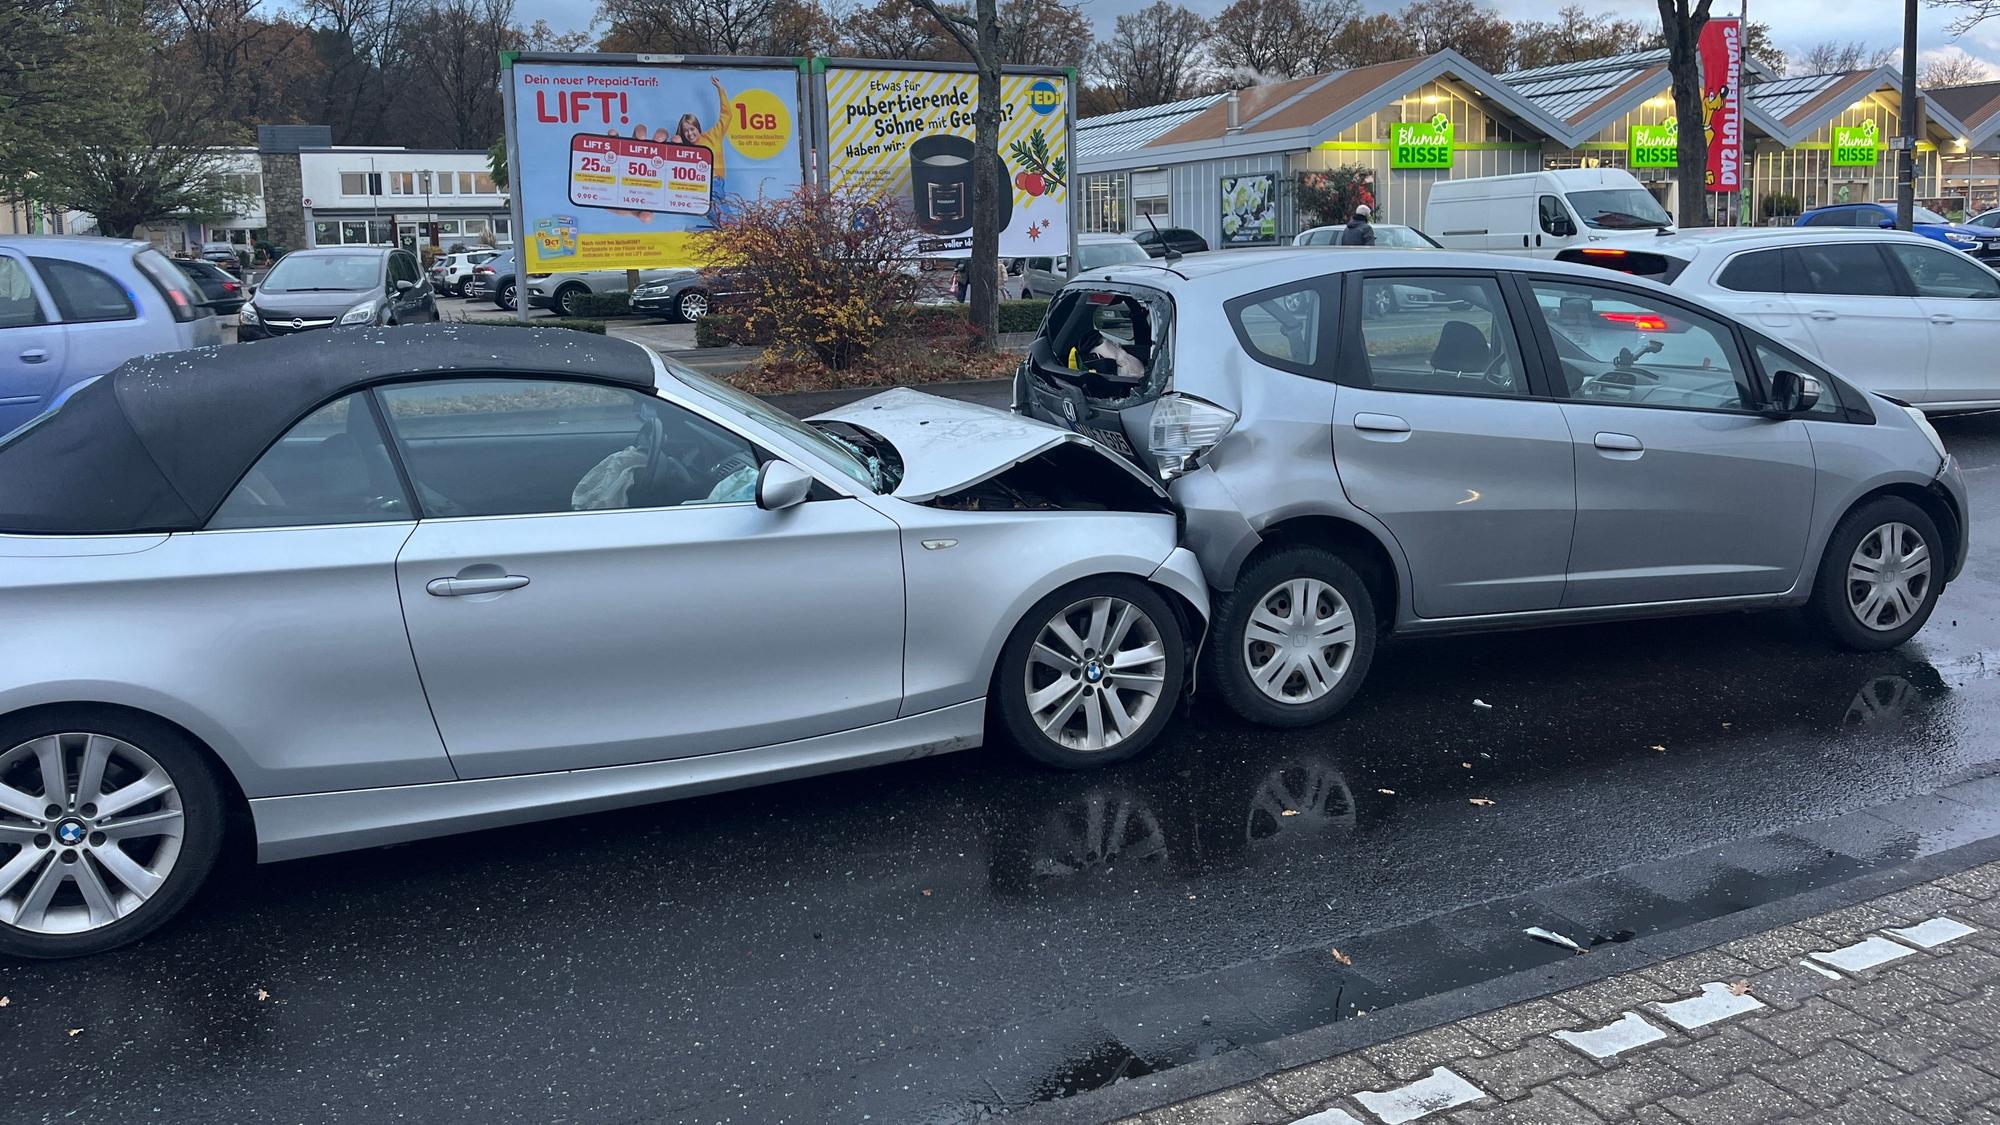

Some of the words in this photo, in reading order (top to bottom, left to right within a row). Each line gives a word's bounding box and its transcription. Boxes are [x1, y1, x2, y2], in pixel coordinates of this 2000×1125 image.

[525, 75, 549, 84] Dein
[553, 77, 583, 85] neuer
[587, 76, 659, 88] Prepaid-Tarif:
[870, 80, 901, 91] Etwas
[905, 80, 921, 92] für
[537, 90, 629, 124] LIFT!
[846, 86, 969, 124] pubertierende
[875, 114, 924, 137] Söhne
[928, 116, 947, 129] mit
[1398, 126, 1448, 146] Blumen
[1838, 130, 1873, 147] Blumen
[583, 140, 603, 150] LIFT
[604, 142, 611, 151] S
[629, 145, 648, 155] LIFT
[650, 147, 658, 155] M
[846, 142, 880, 158] Haben
[884, 140, 906, 152] wir:
[676, 150, 695, 159] LIFT
[696, 152, 702, 160] L
[1398, 147, 1448, 163] RISSE
[1636, 148, 1677, 162] RISSE
[1838, 148, 1873, 162] RISSE
[943, 239, 963, 248] voller
